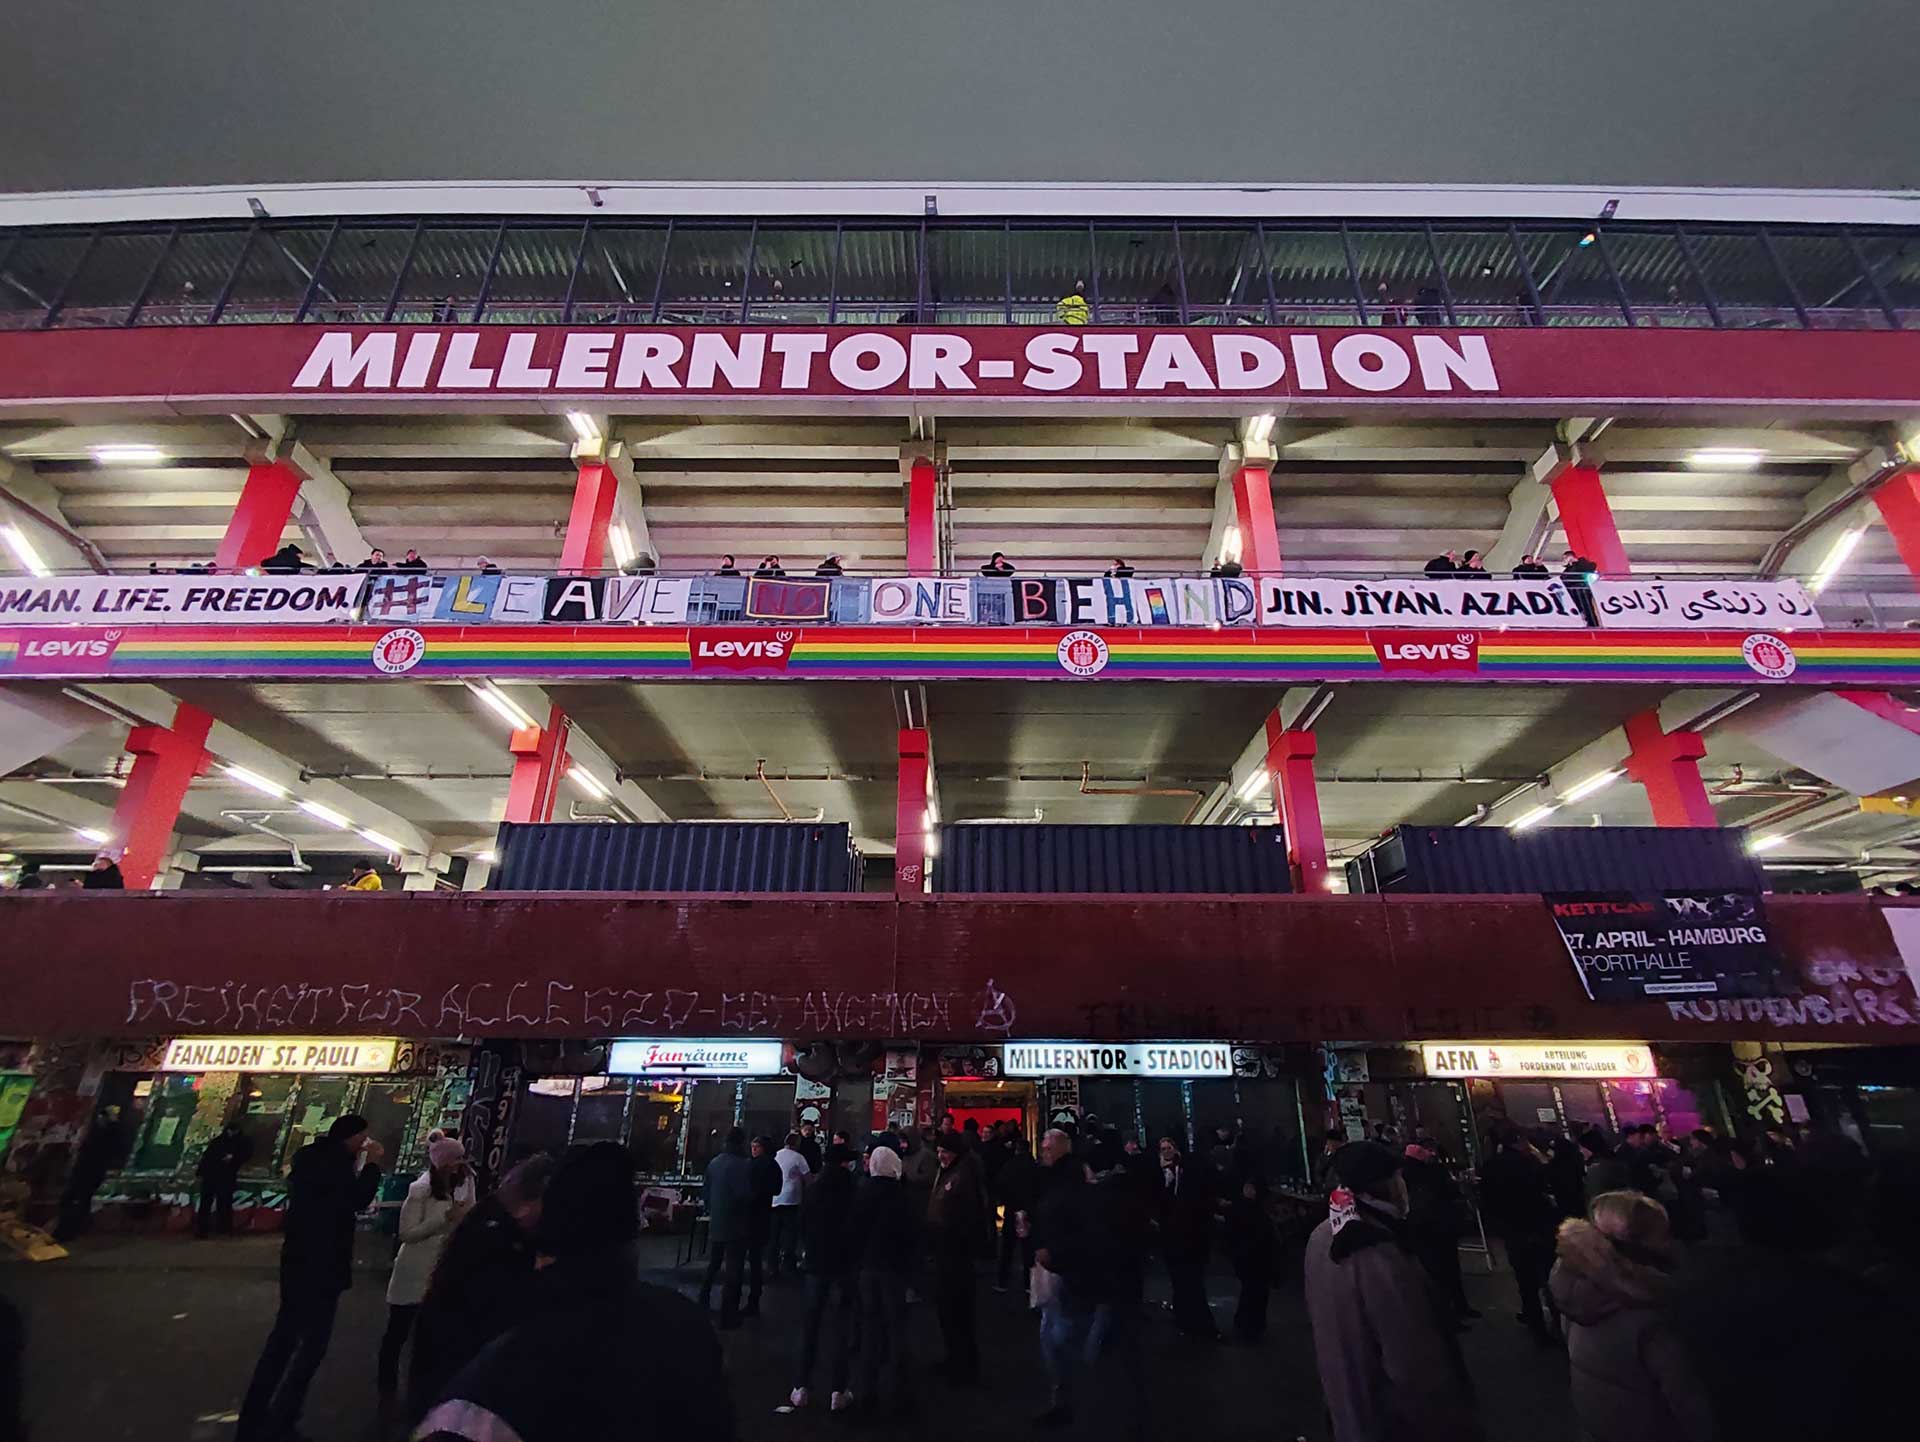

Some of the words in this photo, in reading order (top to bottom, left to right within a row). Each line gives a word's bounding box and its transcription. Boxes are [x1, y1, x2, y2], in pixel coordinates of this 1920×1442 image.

[292, 332, 1499, 392] MILLERNTOR-STADION
[0, 589, 81, 612] MAN.
[92, 588, 171, 612] LIFE.
[181, 586, 349, 612] FREEDOM.
[873, 582, 967, 619] ONE
[1267, 587, 1332, 615] JIN.
[1600, 586, 1668, 615] آزادی
[1082, 633, 1106, 652] PAULI
[1595, 930, 1656, 949] APRIL
[1668, 926, 1767, 947] HAMBURG
[171, 1045, 262, 1066] FANLADEN
[272, 1045, 297, 1066] ST.
[303, 1045, 359, 1066] PAULI
[643, 1045, 749, 1067] Fanräume
[1009, 1049, 1128, 1070] MILLERNTOR
[1147, 1049, 1228, 1070] STADION
[1435, 1051, 1479, 1071] AFM
[1544, 1051, 1588, 1060] ABTEILUNG
[1570, 1062, 1617, 1071] MITGLIEDER
